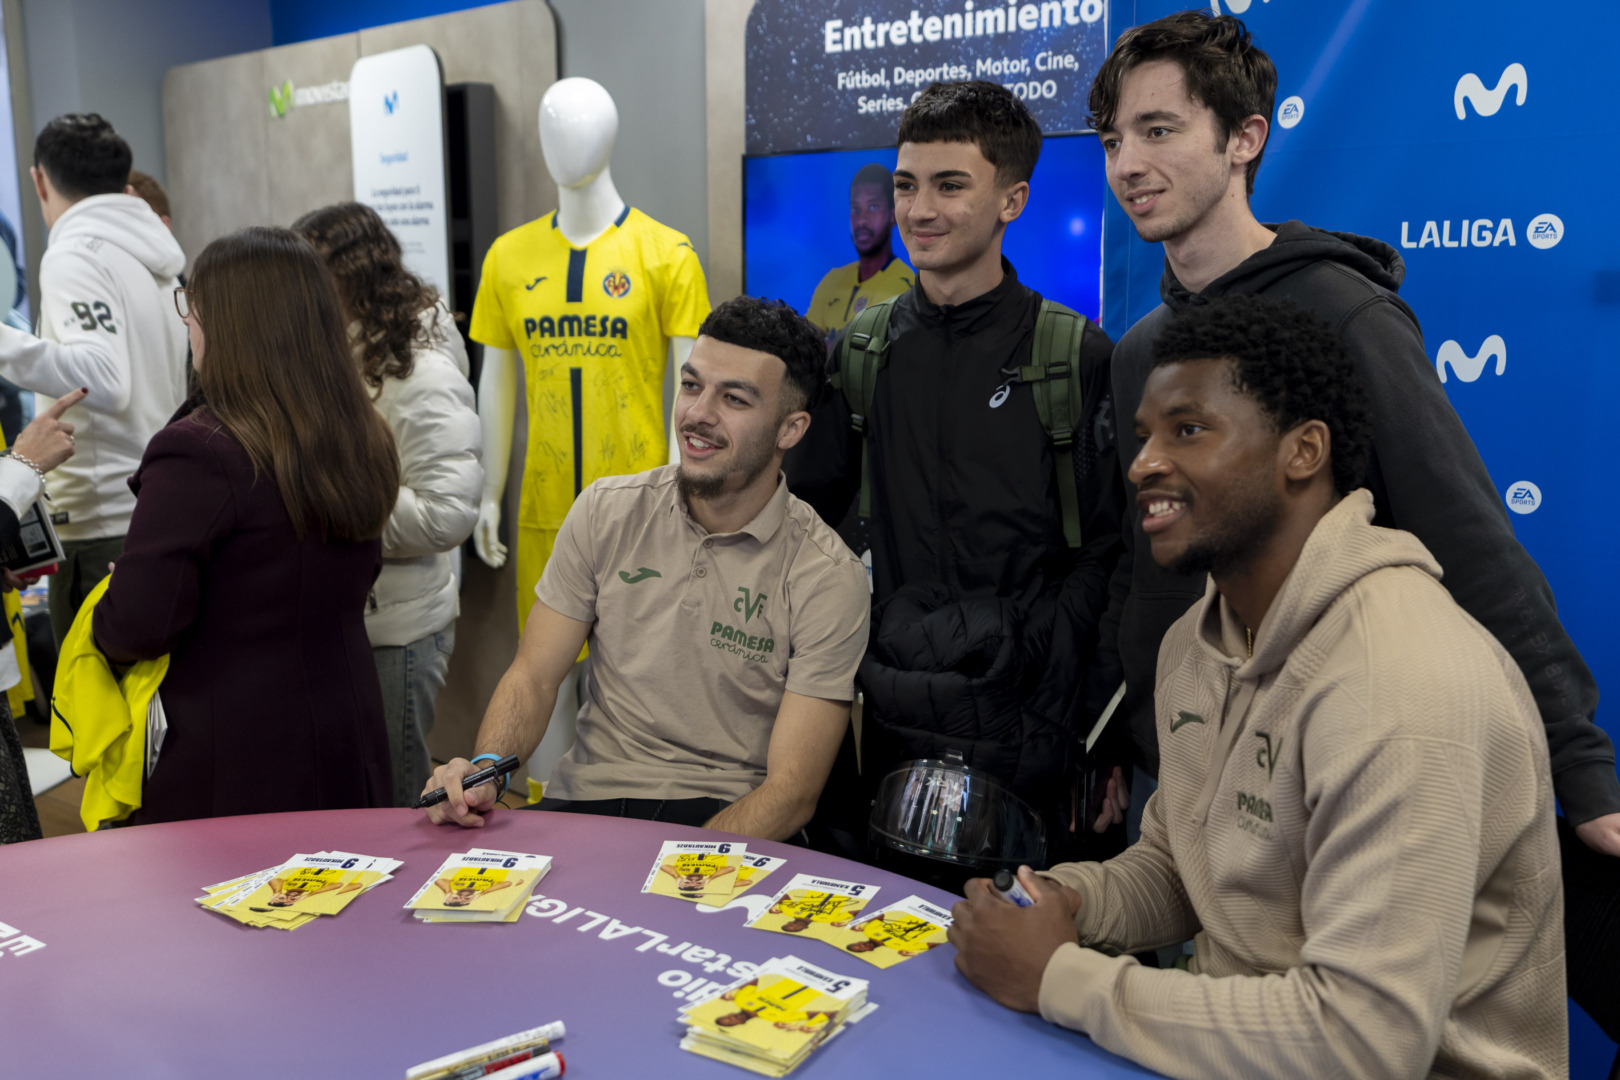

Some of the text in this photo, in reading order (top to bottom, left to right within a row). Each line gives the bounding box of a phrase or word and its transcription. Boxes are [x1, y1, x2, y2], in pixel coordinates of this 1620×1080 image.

[824, 0, 1104, 53] Entretenimiento
[837, 50, 1080, 90] Fútbol, Deportes, Motor, Cine,
[1401, 218, 1516, 248] LALIGA
[1533, 221, 1557, 233] EA
[71, 300, 117, 335] 92
[524, 314, 628, 340] PAMESA
[1512, 487, 1535, 499] EA
[1510, 498, 1536, 506] SPORTS
[710, 621, 775, 653] PAMESA
[718, 843, 732, 854] 9
[340, 857, 360, 869] 9
[502, 857, 519, 868] 9
[752, 857, 771, 868] 9
[848, 884, 866, 896] 5
[825, 980, 851, 994] 5
